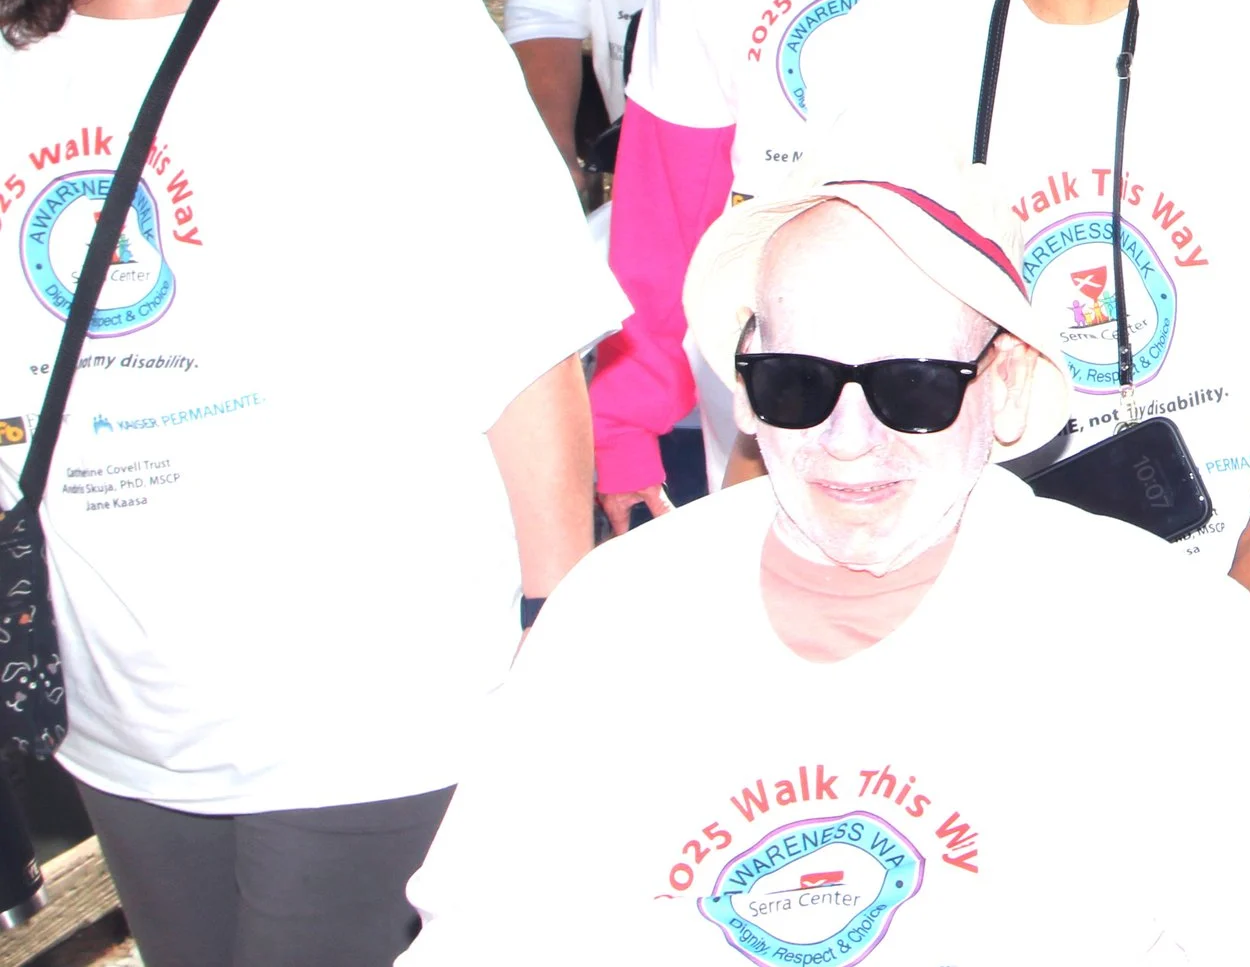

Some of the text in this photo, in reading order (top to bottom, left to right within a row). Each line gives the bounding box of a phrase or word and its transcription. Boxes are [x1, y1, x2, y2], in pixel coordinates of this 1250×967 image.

[765, 150, 789, 163] See
[28, 126, 113, 170] Walk
[146, 136, 171, 177] his
[166, 169, 204, 246] Way
[29, 180, 111, 244] AWARNE
[1091, 168, 1144, 206] Tis
[1151, 192, 1208, 270] Way
[1023, 222, 1114, 284] ARENESS
[90, 313, 122, 328] spect
[125, 310, 136, 322] &
[1101, 318, 1148, 341] Ceter
[30, 364, 50, 375] ee
[93, 356, 116, 370] my
[120, 354, 199, 372] disability.
[1087, 365, 1140, 385] Respt
[1140, 356, 1151, 369] &
[1149, 317, 1171, 356] Choice
[1089, 410, 1119, 428] not
[1147, 387, 1229, 416] disability.
[106, 461, 141, 476] Covell
[144, 459, 171, 471] Trust
[149, 473, 180, 487] MSCP
[1133, 455, 1174, 509] 10:07
[86, 496, 148, 512] Jane Kaasa
[654, 764, 979, 901] 025 Walk This Wy
[871, 831, 906, 868] WA
[749, 890, 861, 917] Serra Center
[729, 904, 888, 967] Dignity, Respect & Choice
